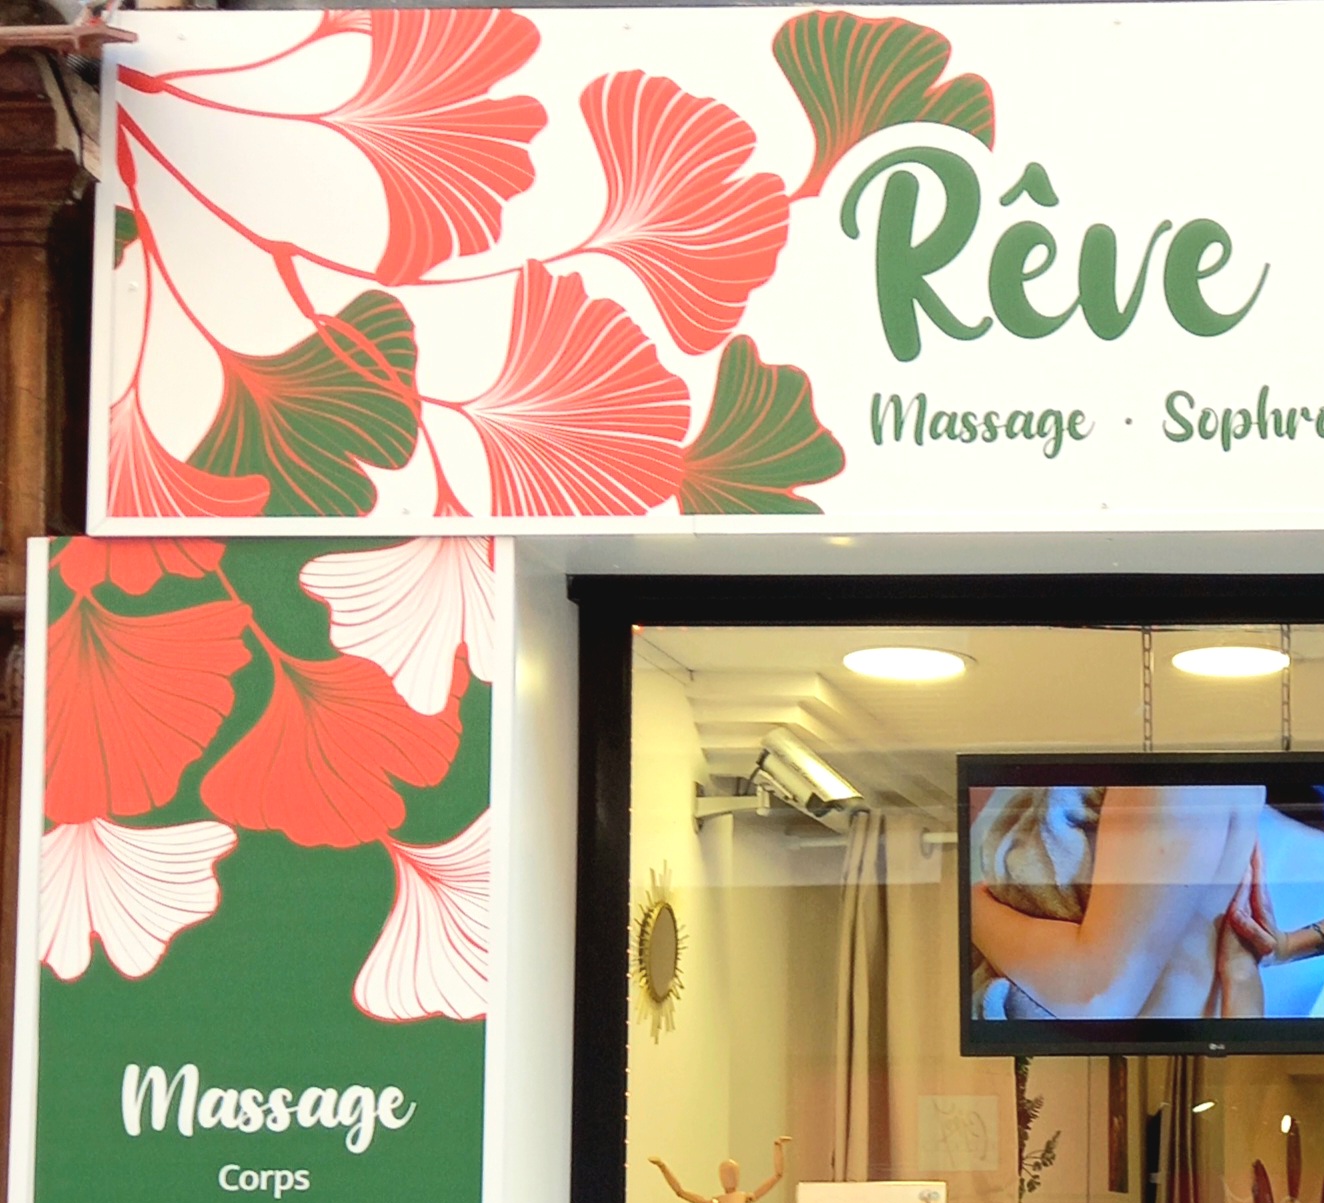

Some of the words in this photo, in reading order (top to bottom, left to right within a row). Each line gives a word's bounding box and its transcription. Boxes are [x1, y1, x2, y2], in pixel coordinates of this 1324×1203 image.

[840, 146, 1270, 362] Rêve
[870, 392, 1094, 459] Massage
[121, 1063, 417, 1154] Massage
[218, 1164, 310, 1199] Corps
